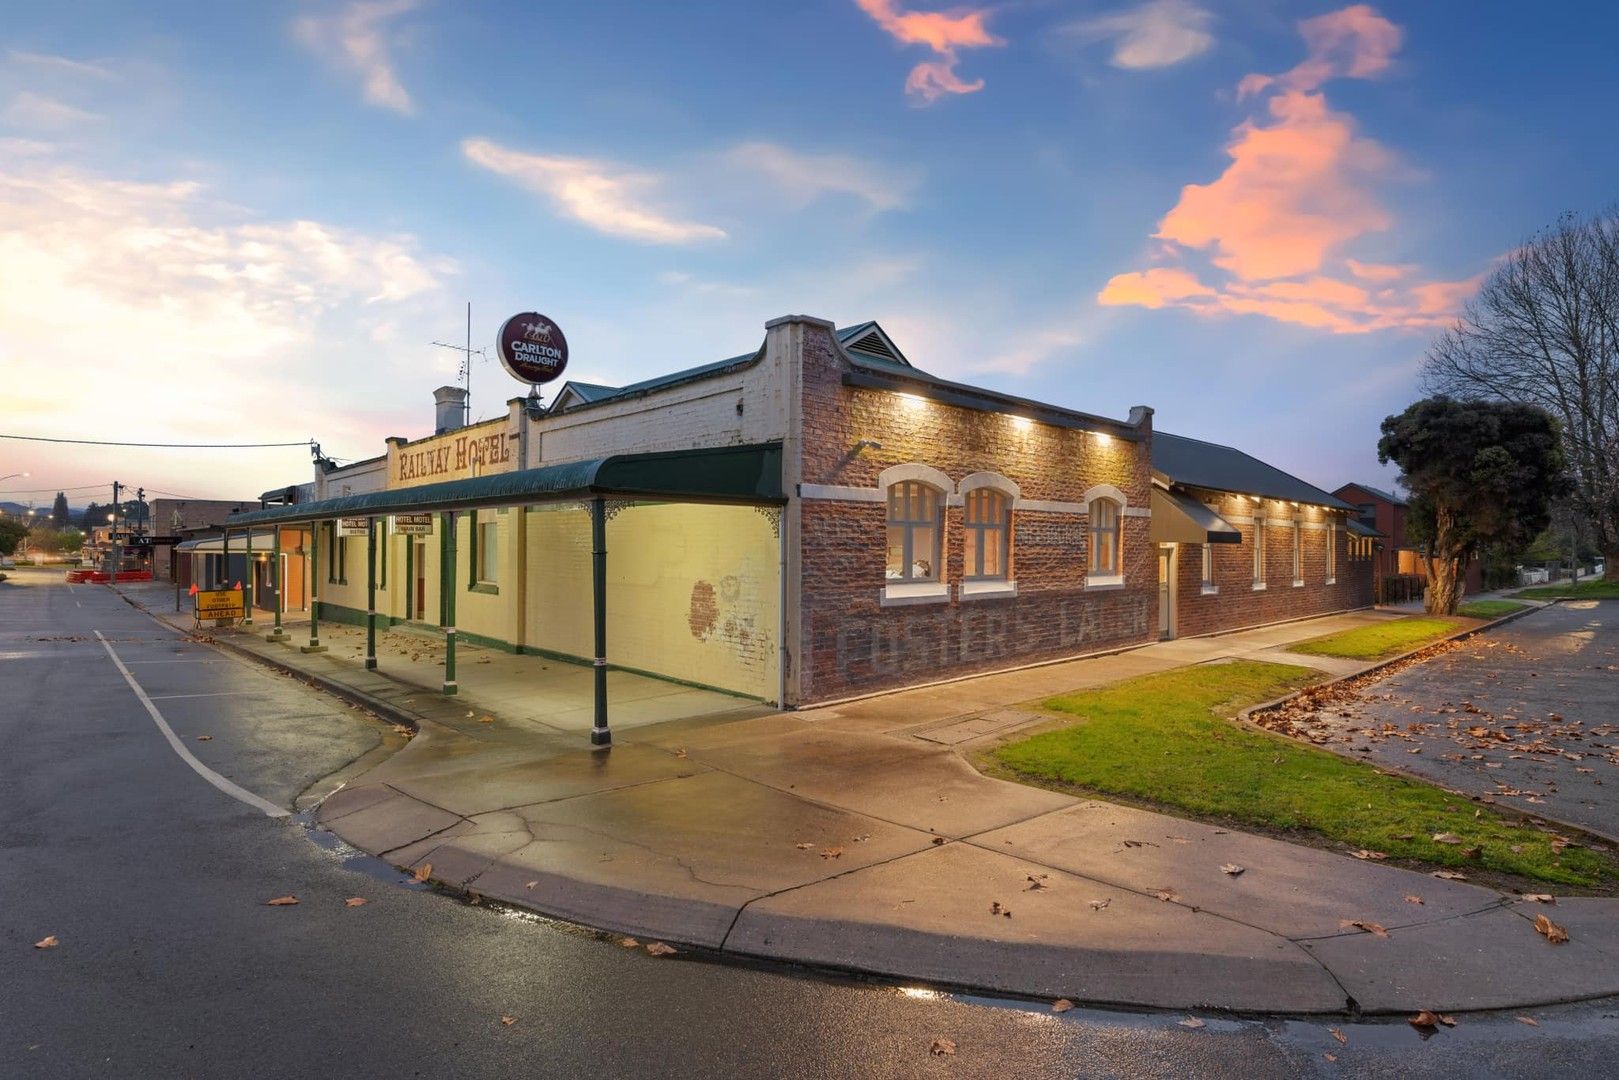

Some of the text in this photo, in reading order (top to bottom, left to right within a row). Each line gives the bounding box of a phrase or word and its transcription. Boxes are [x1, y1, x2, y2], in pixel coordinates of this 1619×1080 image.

[511, 341, 562, 359] CARLTON
[515, 351, 559, 367] DRAUGHT
[399, 433, 509, 480] RAILWAY HOTEL
[395, 515, 431, 523] HOTEL MOTEL
